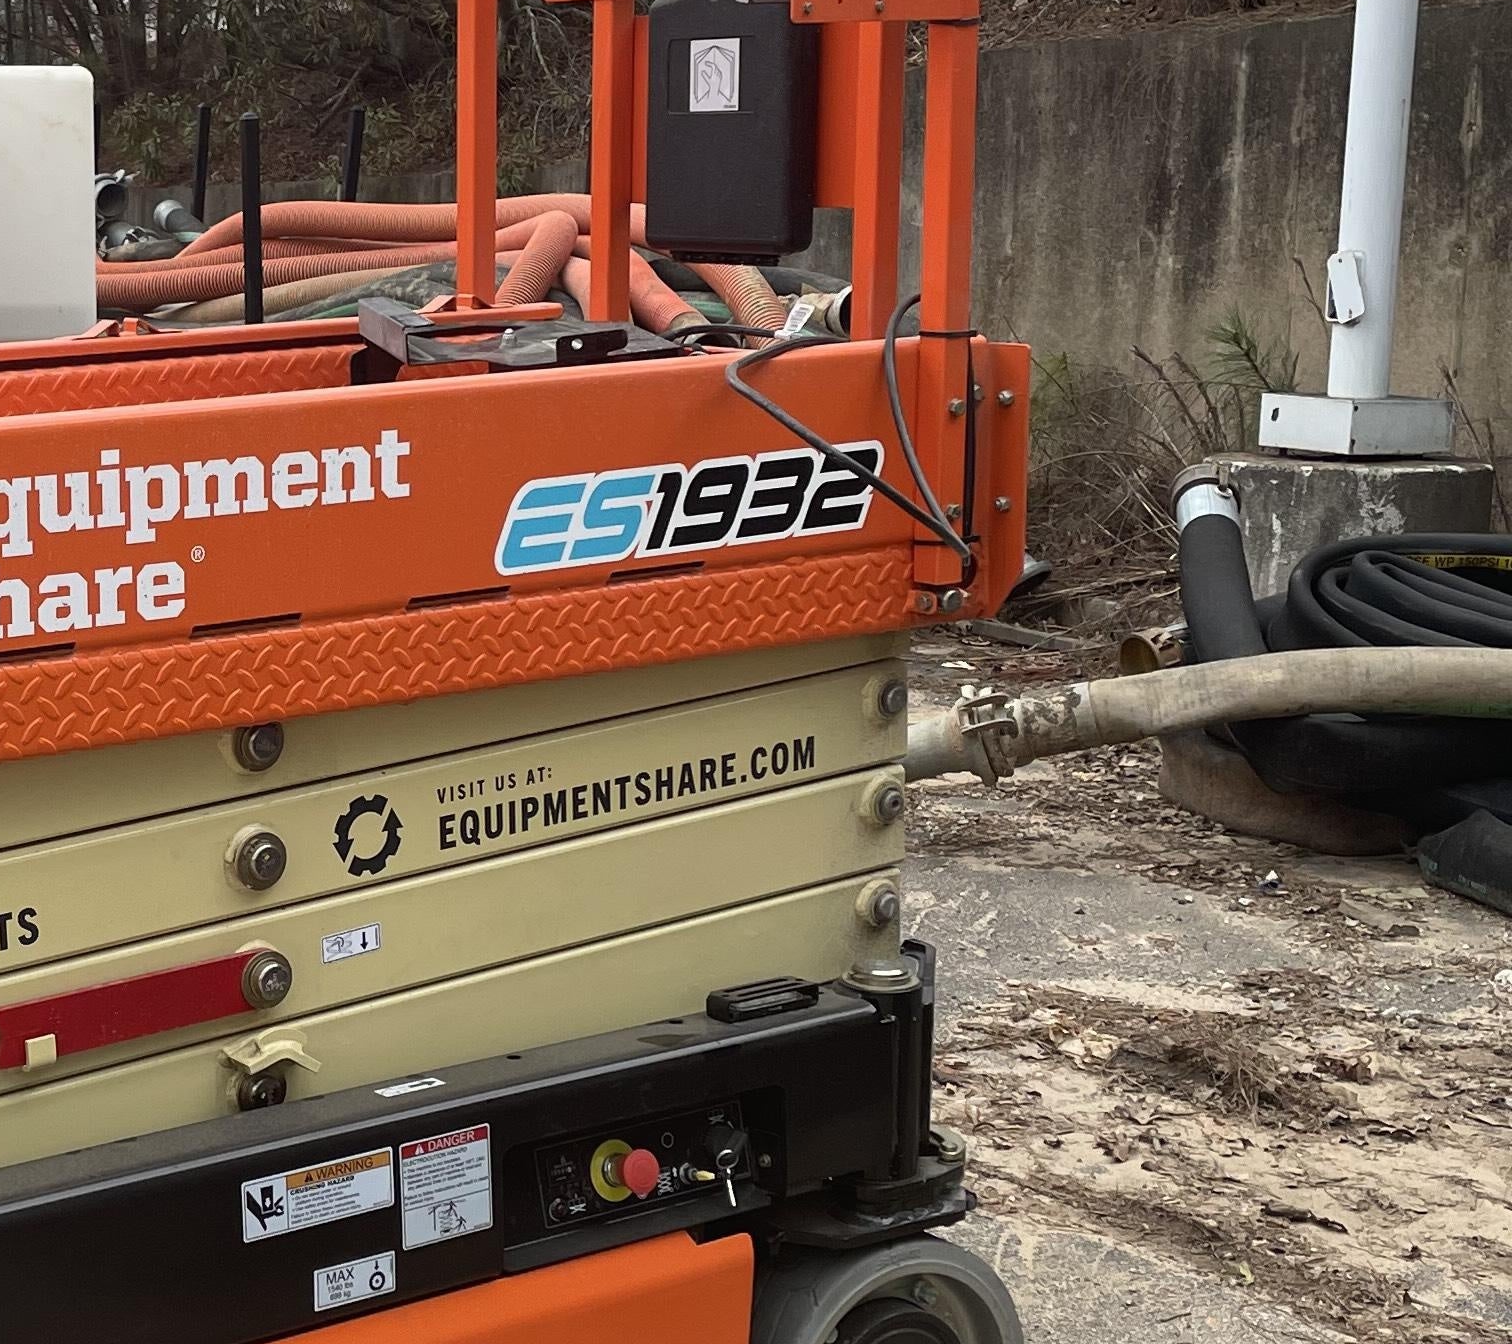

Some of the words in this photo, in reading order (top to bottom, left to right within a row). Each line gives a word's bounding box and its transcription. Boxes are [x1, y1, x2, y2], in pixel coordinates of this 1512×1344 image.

[498, 444, 882, 572] ES1932
[437, 778, 486, 805] VISIT
[494, 772, 518, 793] US
[525, 765, 553, 784] AT:
[438, 735, 816, 851] EQUIPMENTSHARE.COM
[428, 1130, 476, 1152] DANGER
[316, 1157, 374, 1180] WARNING
[327, 1175, 355, 1187] HAZARD
[326, 1266, 355, 1286] MAX
